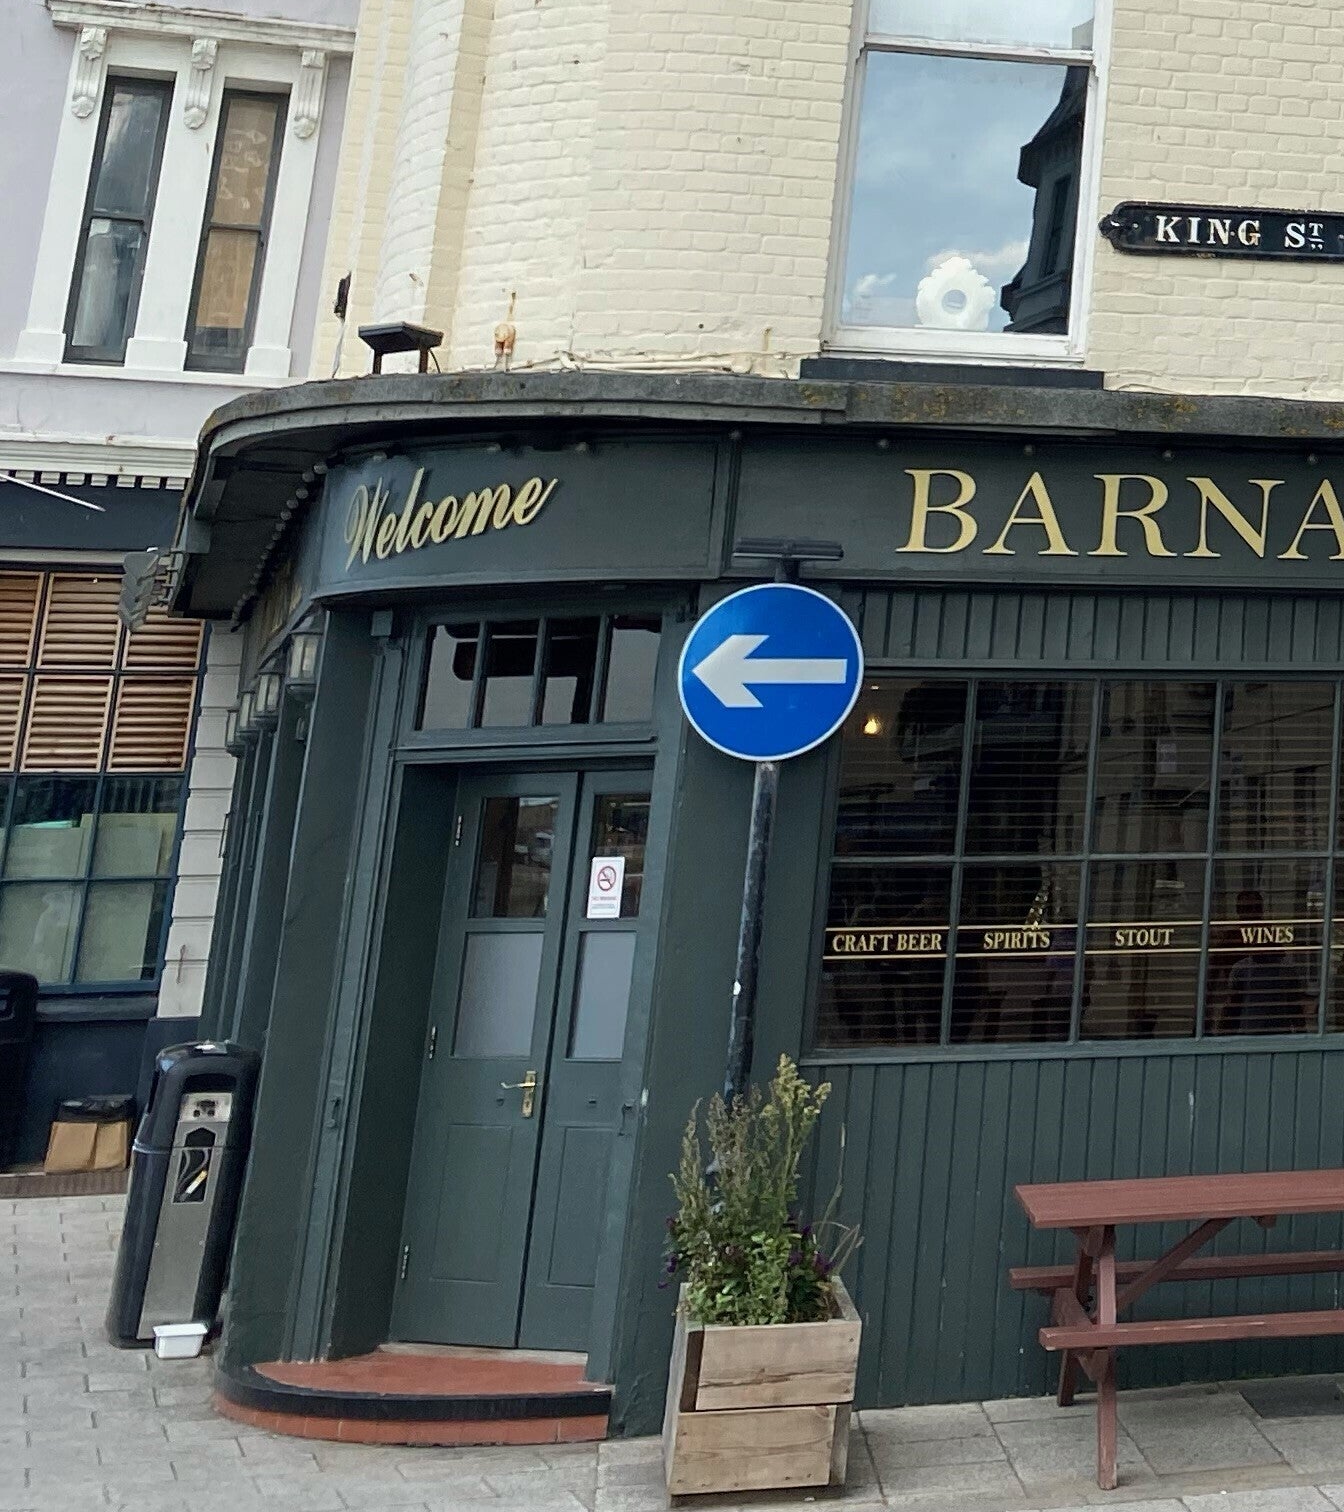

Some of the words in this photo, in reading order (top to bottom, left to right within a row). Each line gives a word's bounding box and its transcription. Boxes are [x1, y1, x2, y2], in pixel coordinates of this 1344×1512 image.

[1154, 215, 1261, 247] KING
[344, 467, 558, 572] Welcome
[831, 932, 893, 953] CRAFT
[897, 931, 942, 952] BEER
[983, 929, 1051, 951] SPIRITS
[1114, 927, 1174, 947] STOUT
[1240, 925, 1294, 945] WINES
